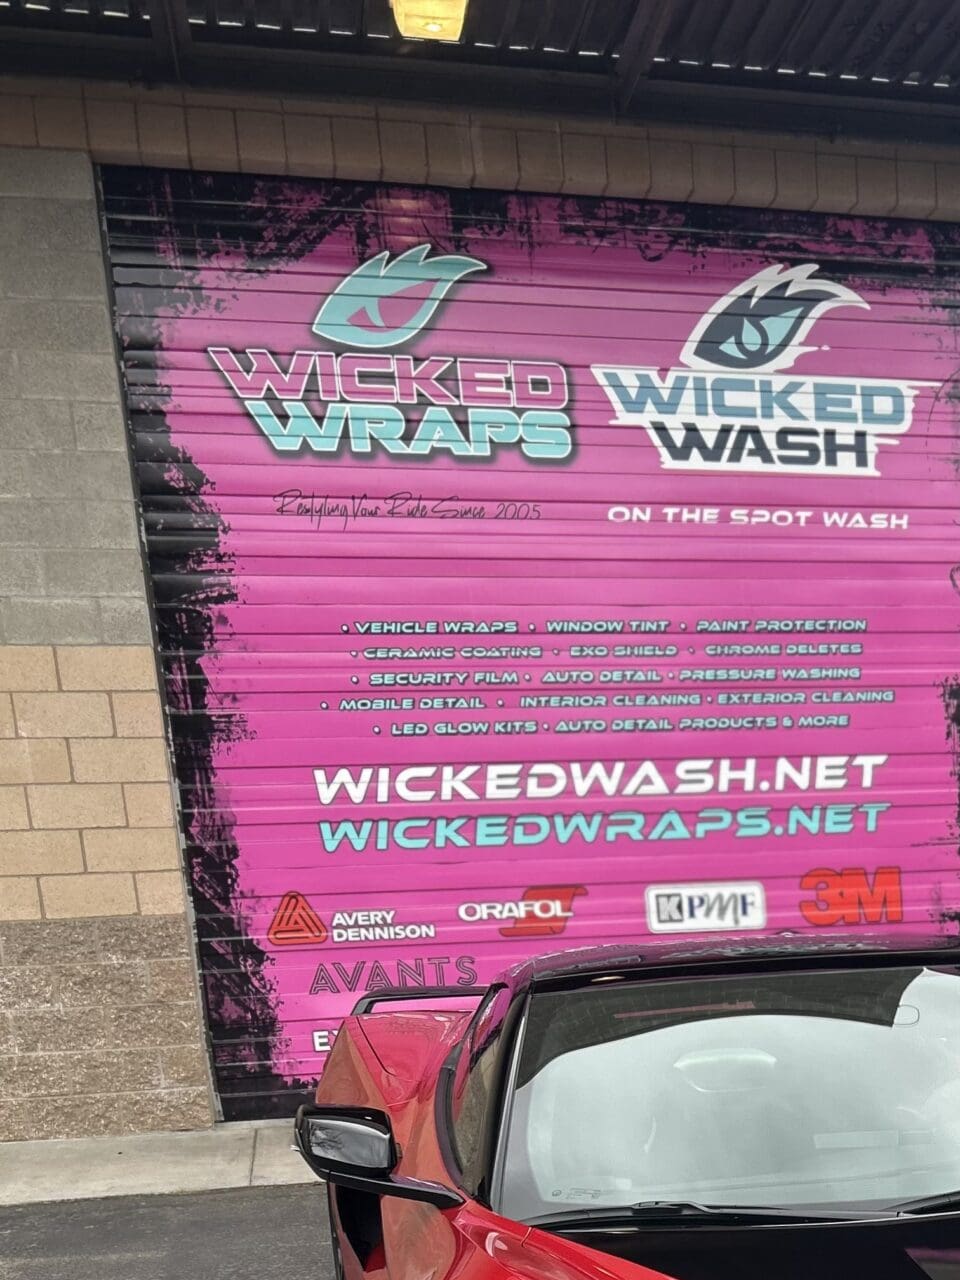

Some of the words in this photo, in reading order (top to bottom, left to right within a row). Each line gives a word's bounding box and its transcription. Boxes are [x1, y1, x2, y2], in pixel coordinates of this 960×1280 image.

[207, 347, 569, 409] WICKED
[603, 371, 905, 425] WICKED
[244, 400, 572, 458] WRAPS
[650, 421, 869, 467] WASH
[384, 491, 427, 518] Ride
[431, 496, 485, 519] Since
[495, 503, 541, 520] 2005
[608, 506, 651, 523] ON
[662, 507, 720, 524] THE
[730, 509, 813, 527] SPOT
[823, 511, 909, 529] WASH
[354, 621, 438, 634] VEHICLE
[443, 621, 518, 633] WRAPS
[546, 620, 624, 633] WINDOW
[629, 620, 670, 632] TINT
[697, 620, 750, 632] PAINT
[755, 619, 867, 631] PROTECTION
[363, 647, 455, 659] CERAMIC
[459, 646, 542, 658] COATING
[570, 646, 608, 657] EXO
[613, 645, 678, 656] SHIELD
[705, 644, 781, 656] CHROME
[786, 643, 862, 655] DELETES
[369, 672, 469, 685] SECURITY
[473, 672, 518, 684] FILM
[541, 671, 594, 683] AUTO
[599, 670, 662, 682] DETAIL
[679, 669, 776, 680] PRESSURE
[782, 667, 861, 679] WASHING
[339, 699, 415, 710] MOBILE
[419, 697, 486, 709] DETAIL
[520, 696, 607, 708] INTERIOR
[612, 694, 701, 706] CLEANING
[717, 692, 807, 704] EXTERIOR
[811, 690, 894, 703] CLEANING
[391, 723, 428, 735] LED
[433, 722, 489, 734] GLOW
[494, 721, 537, 733] KITS
[554, 720, 606, 732] AUTO
[611, 718, 673, 731] DETAIL
[679, 716, 777, 729] PRODUCTS
[782, 716, 793, 728] &
[798, 715, 849, 727] MORE
[313, 755, 888, 805] WICKEDWASH.NET
[318, 803, 892, 853] WICKEDWRAPS.NET
[656, 891, 755, 926] KPMF
[800, 867, 903, 926] 3M
[332, 911, 395, 927] AVERY
[458, 901, 573, 922] ORAFOL
[332, 924, 435, 942] DENNISON
[309, 956, 478, 995] AVANTS
